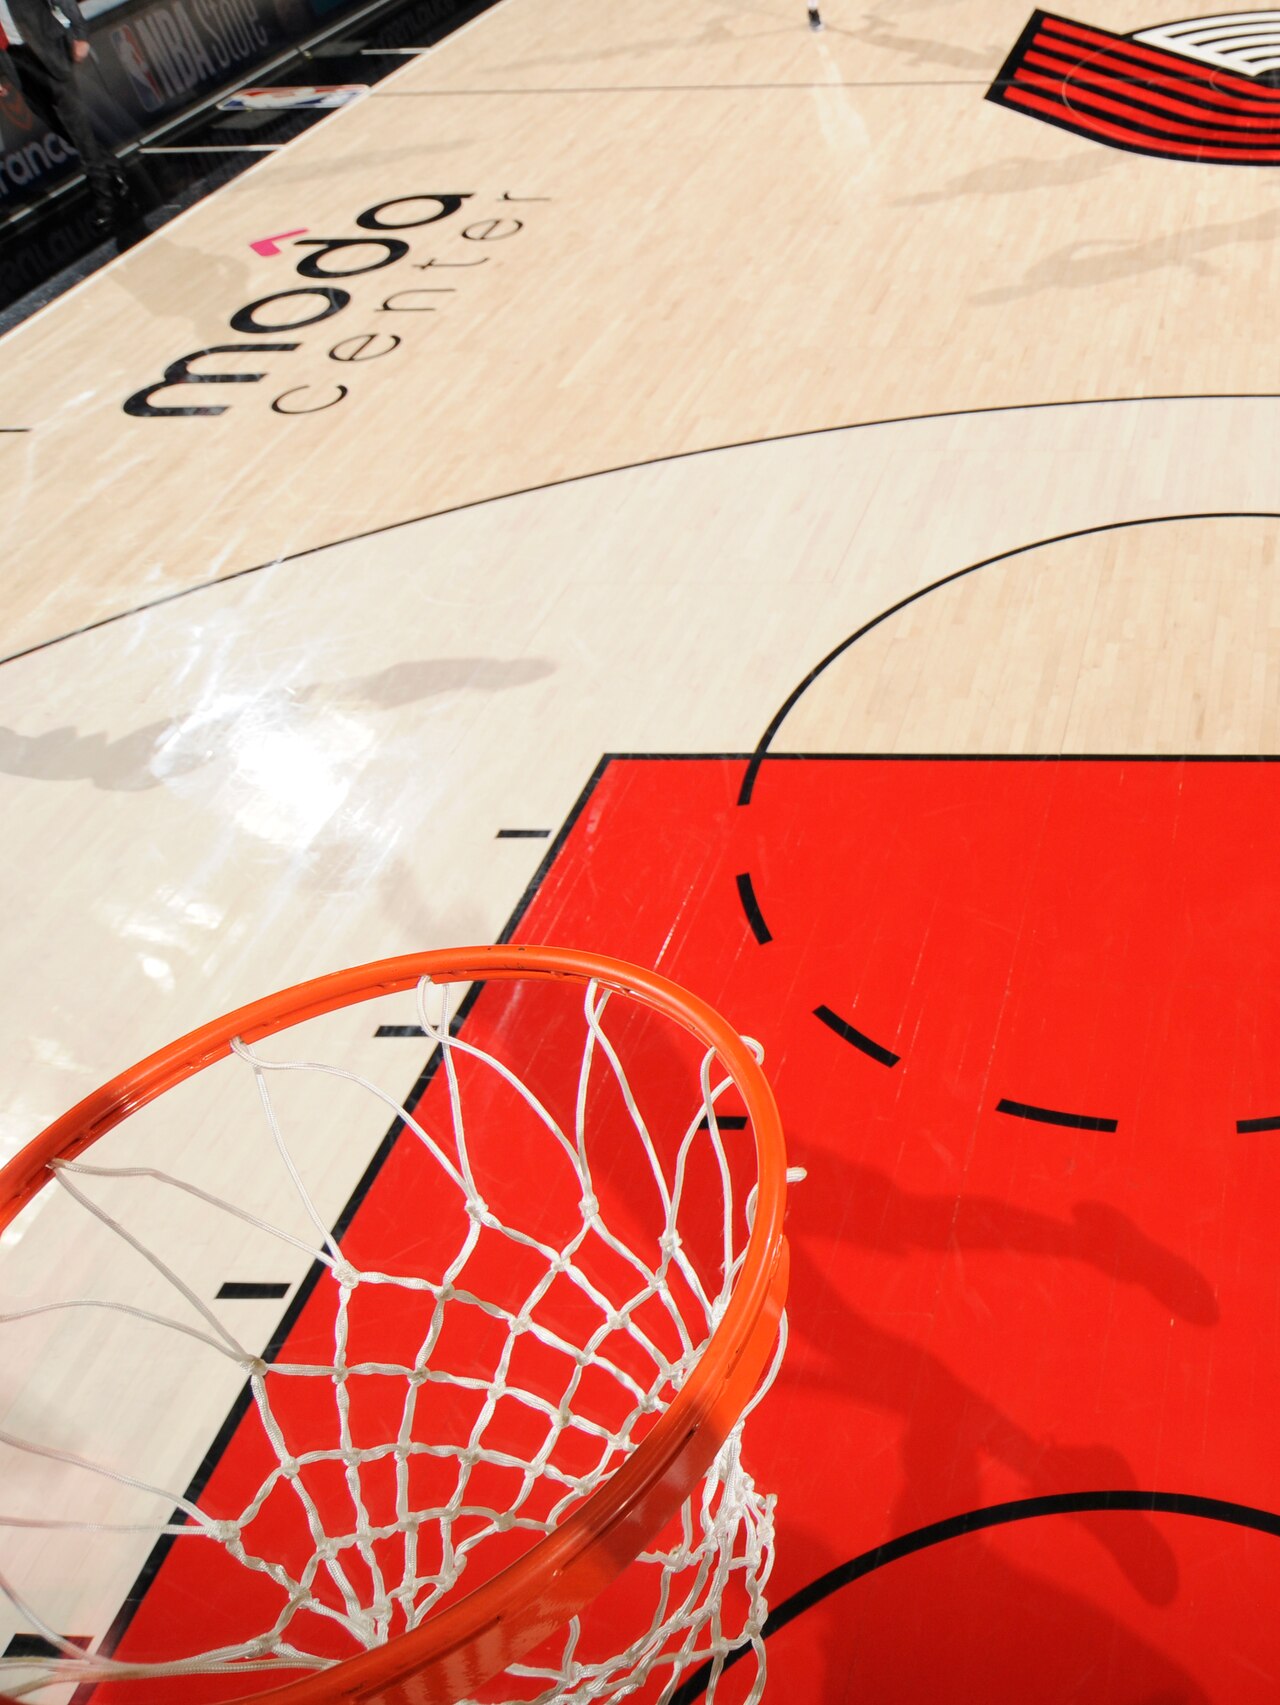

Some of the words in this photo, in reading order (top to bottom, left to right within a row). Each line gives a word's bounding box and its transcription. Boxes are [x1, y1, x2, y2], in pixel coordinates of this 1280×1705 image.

[134, 1, 216, 98] NBA
[193, 0, 268, 68] Store
[122, 193, 475, 417] moda
[271, 190, 551, 415] center
